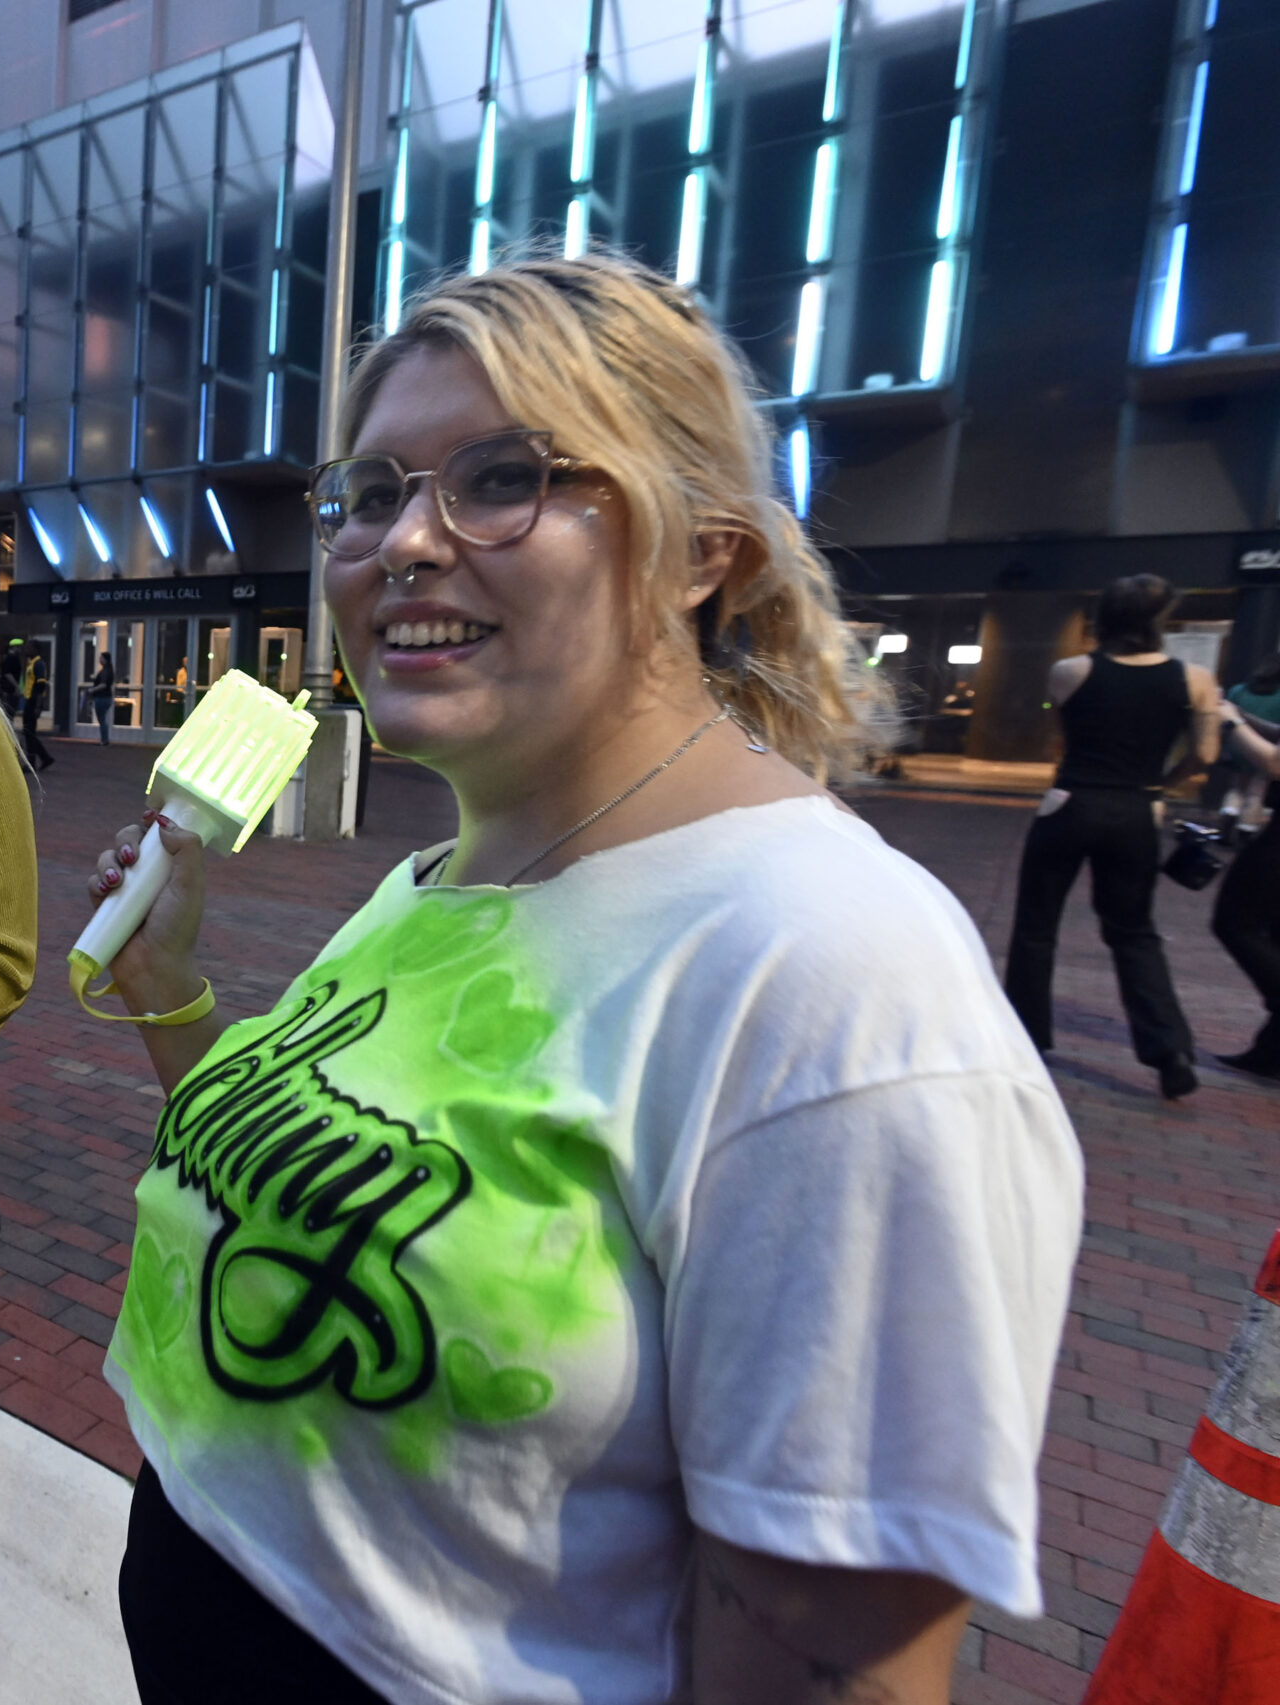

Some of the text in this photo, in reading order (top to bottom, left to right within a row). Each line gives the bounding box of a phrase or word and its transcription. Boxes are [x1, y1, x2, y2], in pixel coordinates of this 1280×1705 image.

[93, 591, 111, 601] BOX
[113, 590, 142, 600] OFFICE
[153, 589, 175, 600] WILL
[177, 588, 202, 598] CALL
